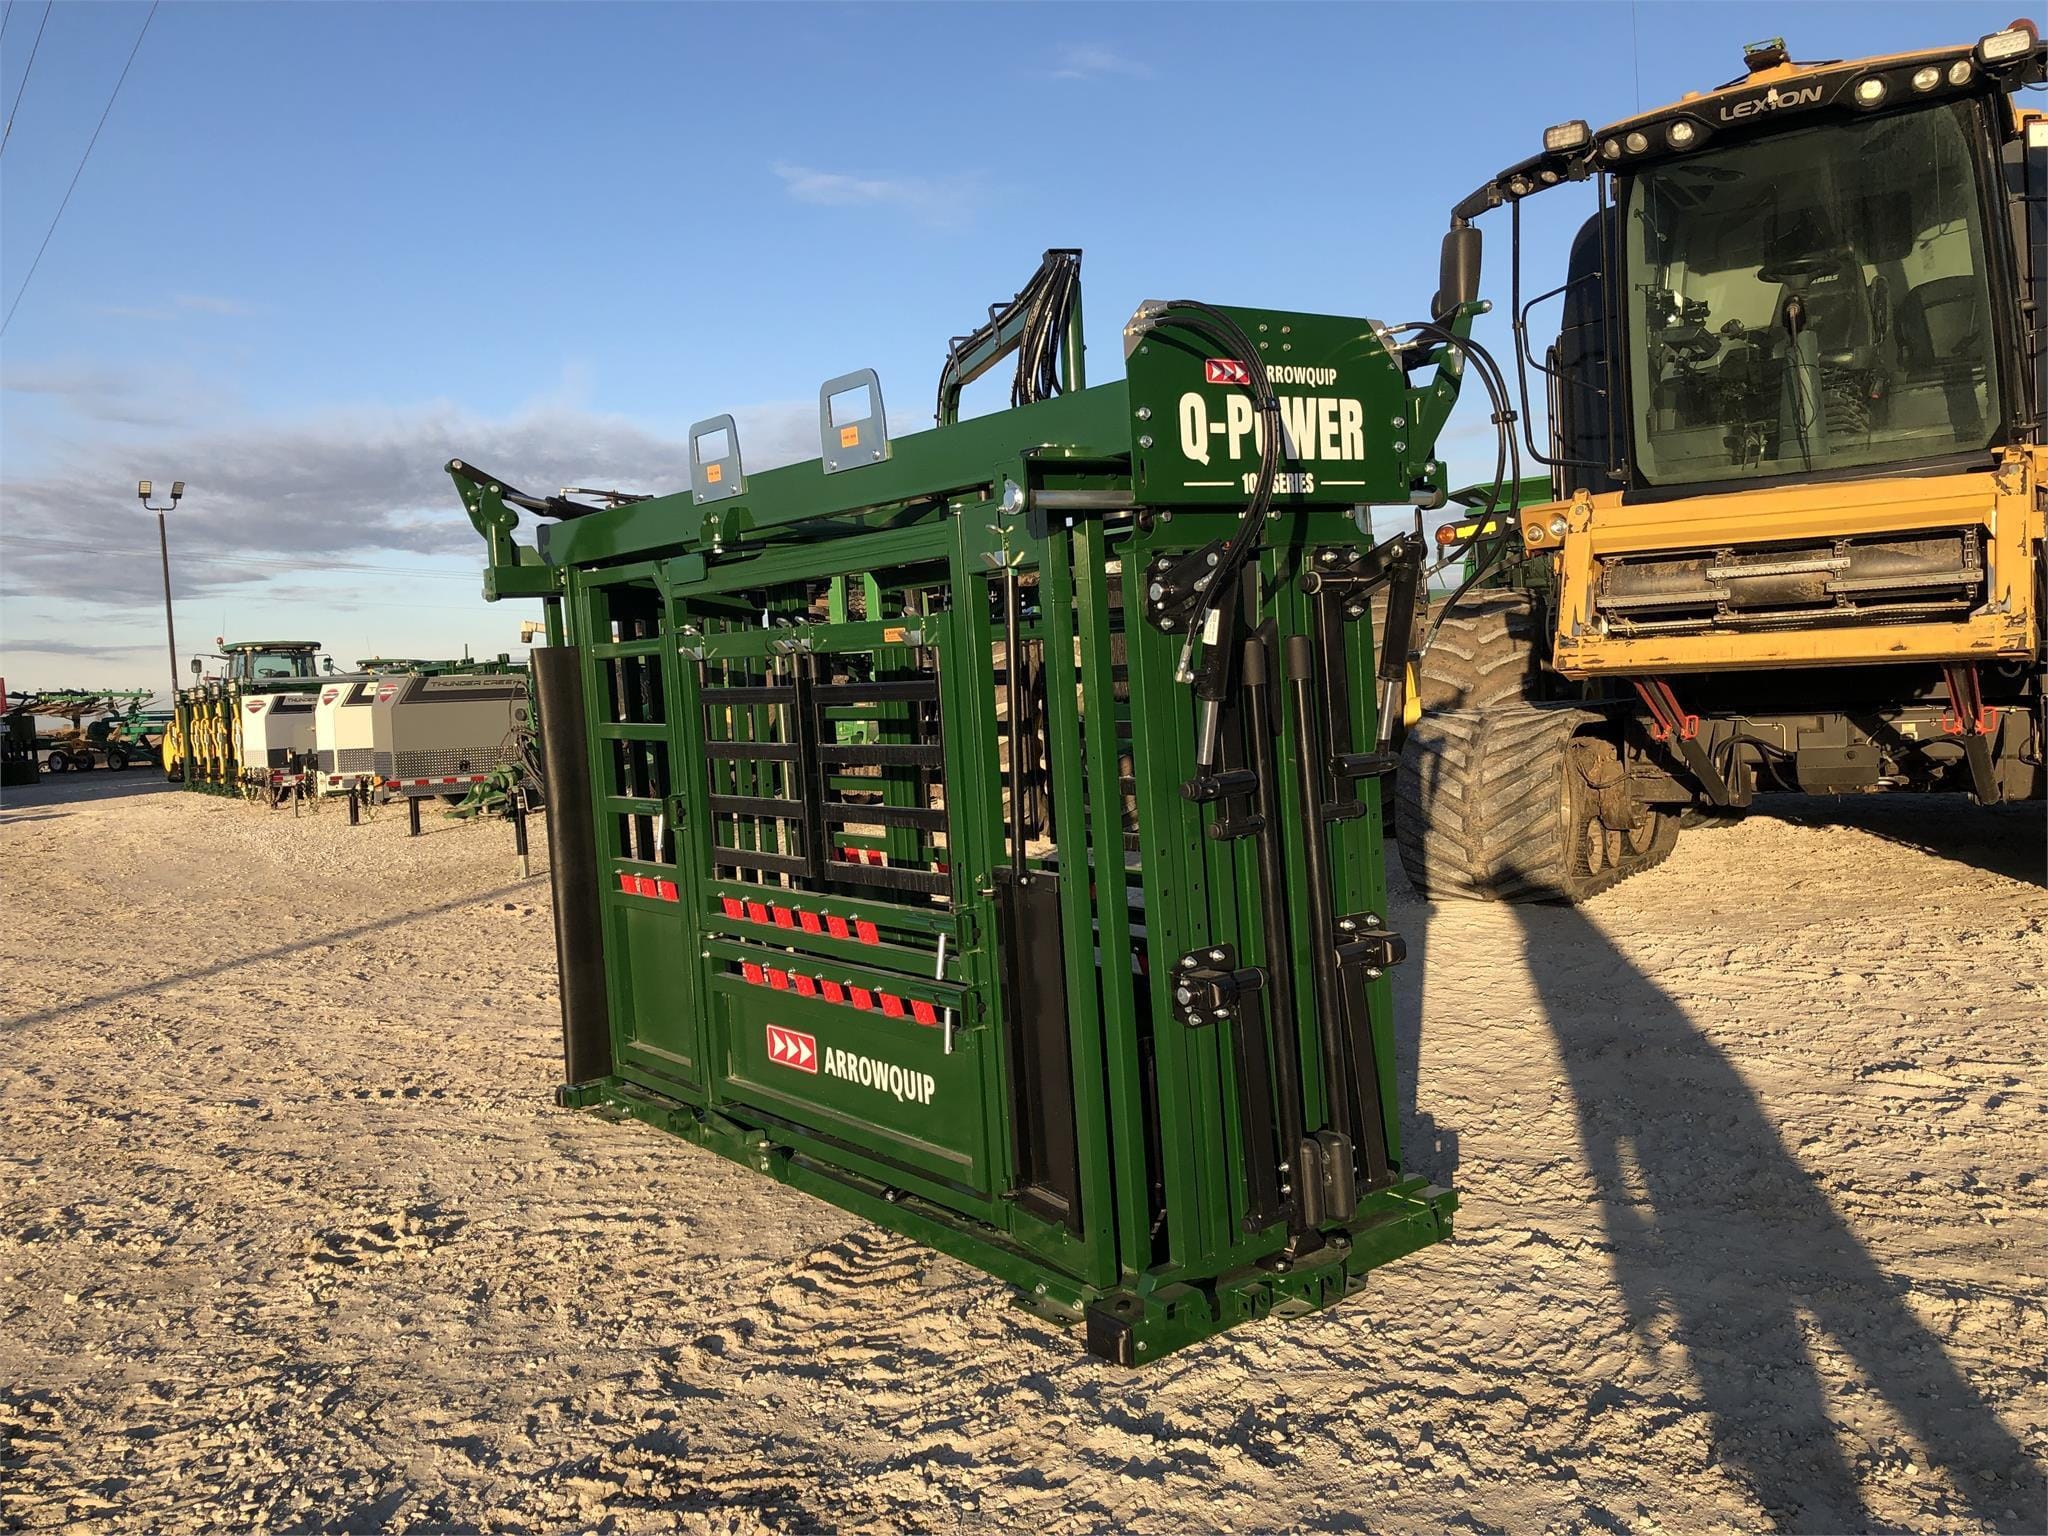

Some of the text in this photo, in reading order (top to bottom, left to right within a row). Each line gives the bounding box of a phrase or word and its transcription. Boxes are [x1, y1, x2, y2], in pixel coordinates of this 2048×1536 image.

[1264, 365, 1337, 388] RROWQUIP
[1241, 472, 1315, 494] 10 SERIES
[824, 1046, 935, 1105] ARROWQUIP
